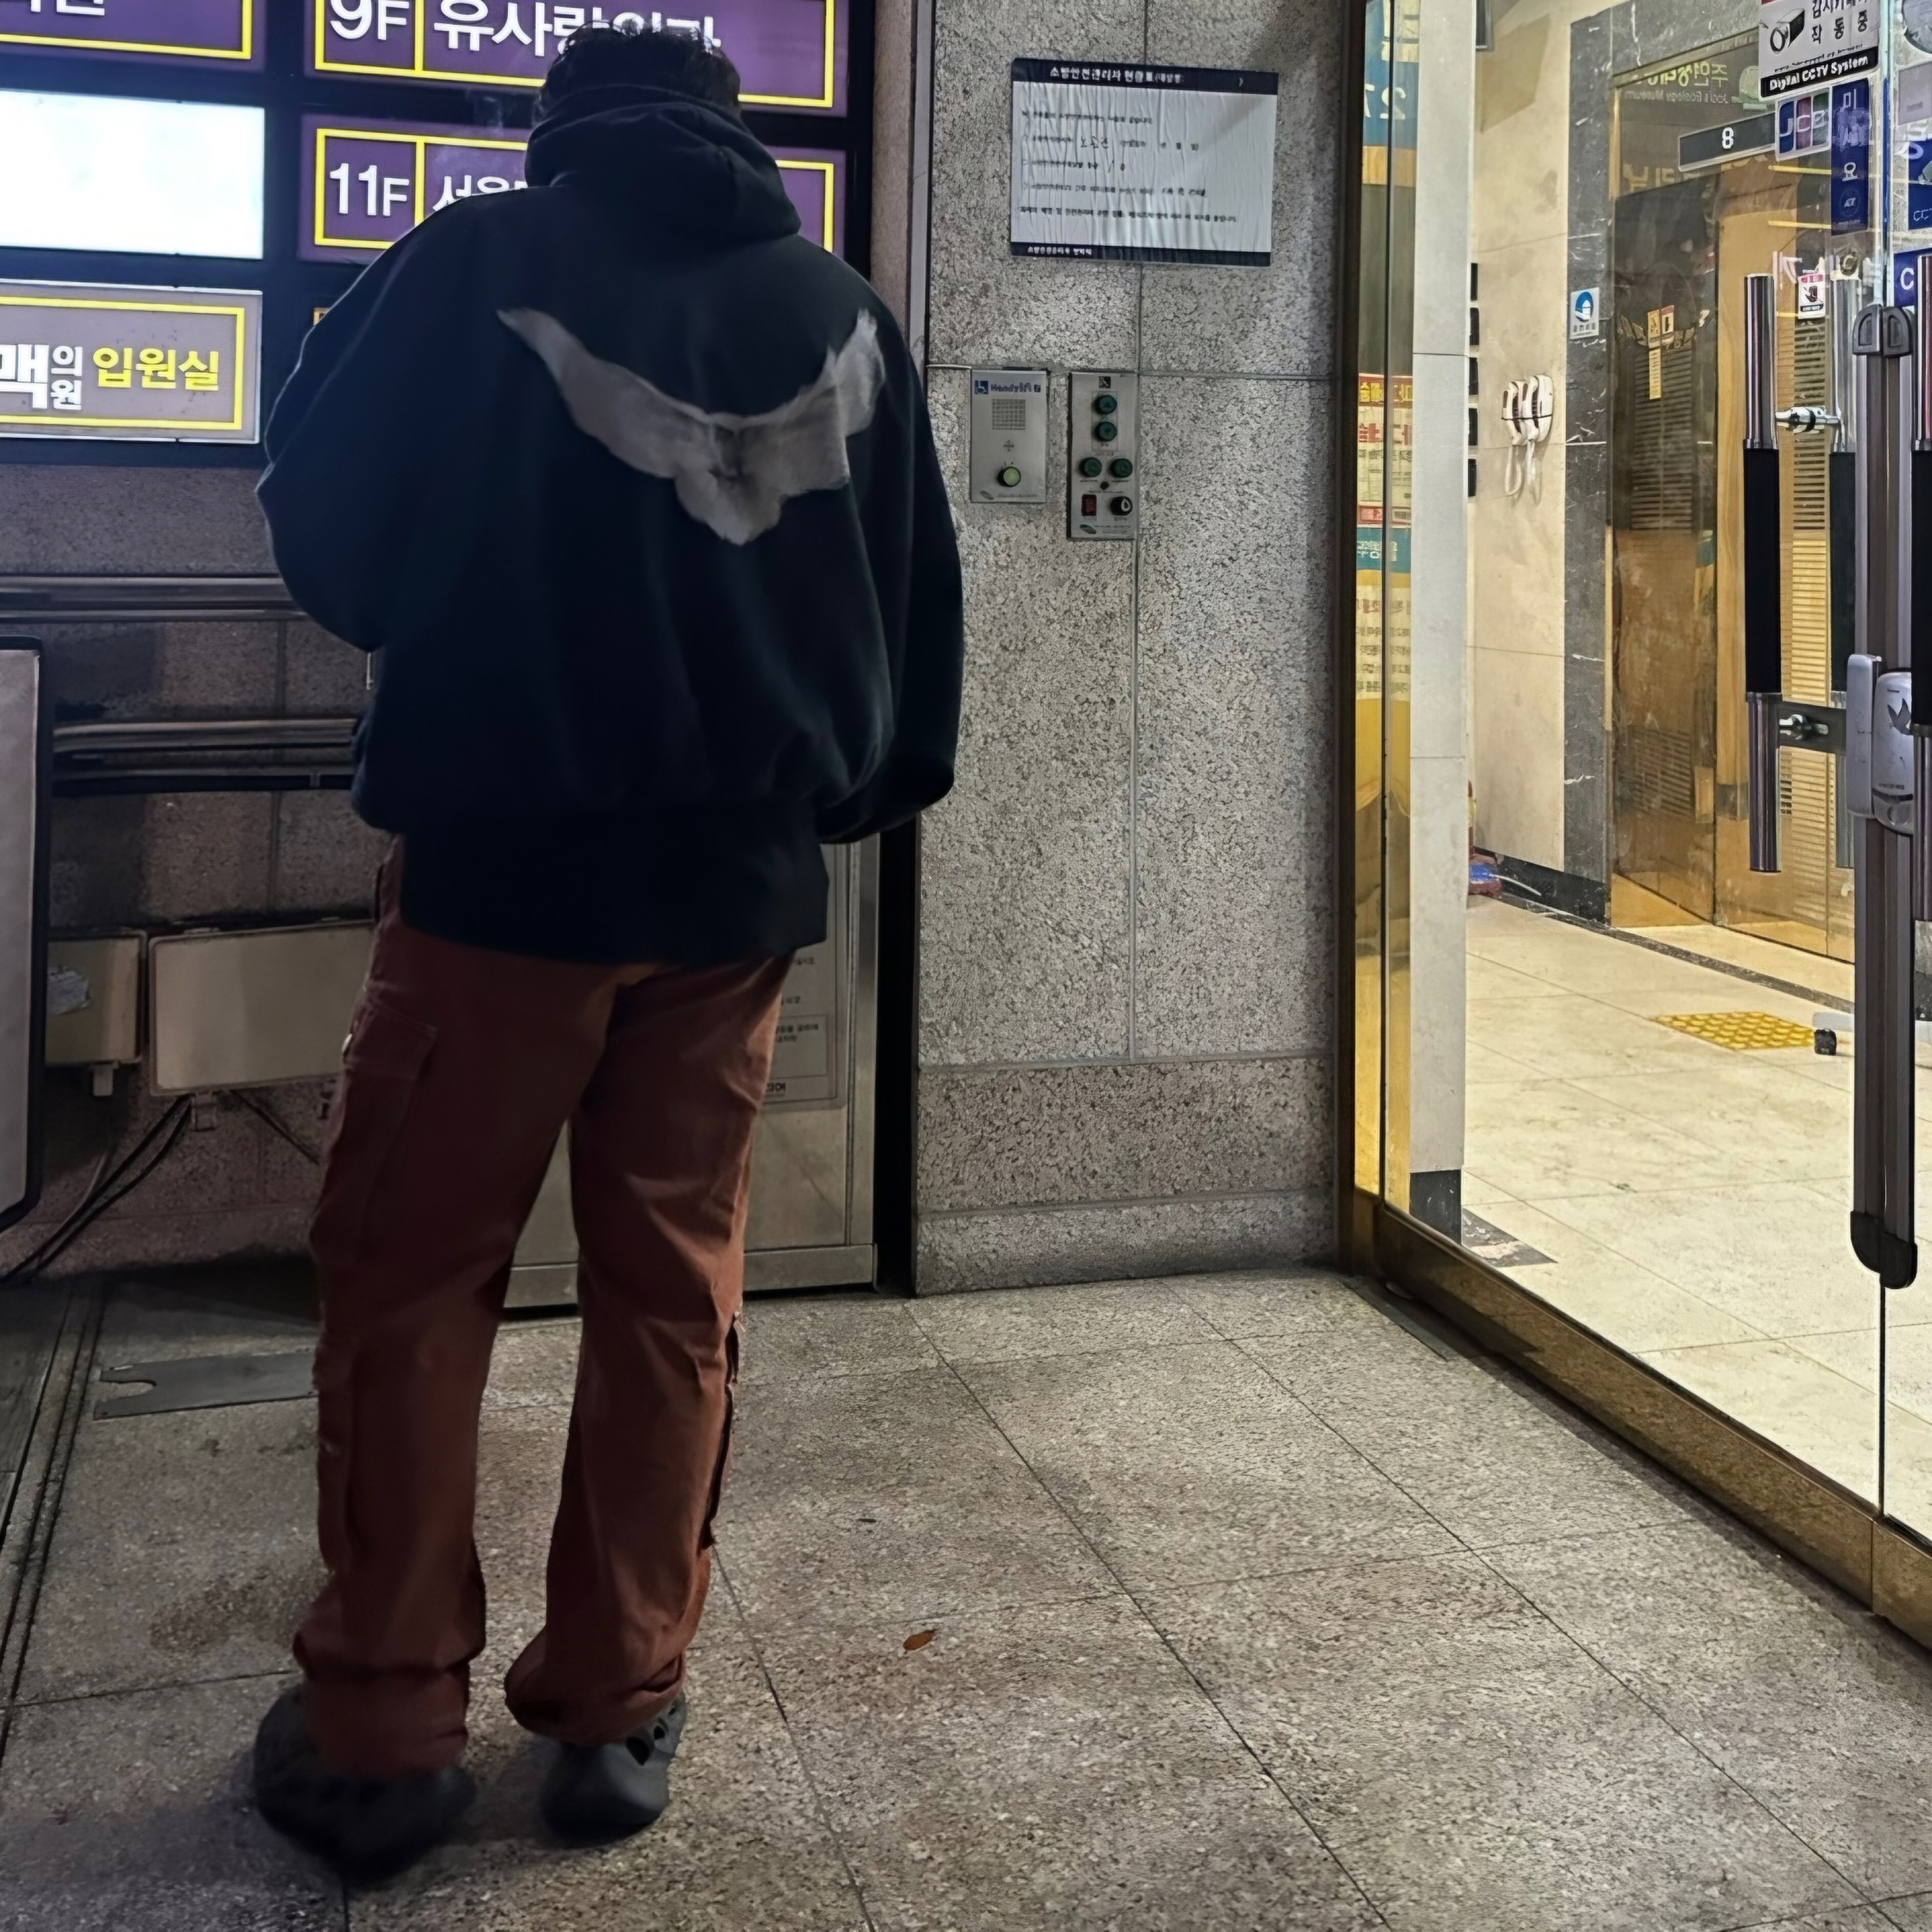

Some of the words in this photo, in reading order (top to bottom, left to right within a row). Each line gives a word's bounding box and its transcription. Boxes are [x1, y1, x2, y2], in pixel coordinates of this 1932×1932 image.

[330, 0, 408, 40] 9F
[1769, 72, 1800, 91] Digital
[1802, 64, 1829, 82] CCTV
[1830, 55, 1868, 76] System
[1722, 127, 1734, 150] 8
[1842, 89, 1860, 182] 미요
[330, 163, 410, 217] 11F
[93, 347, 219, 391] 입원실
